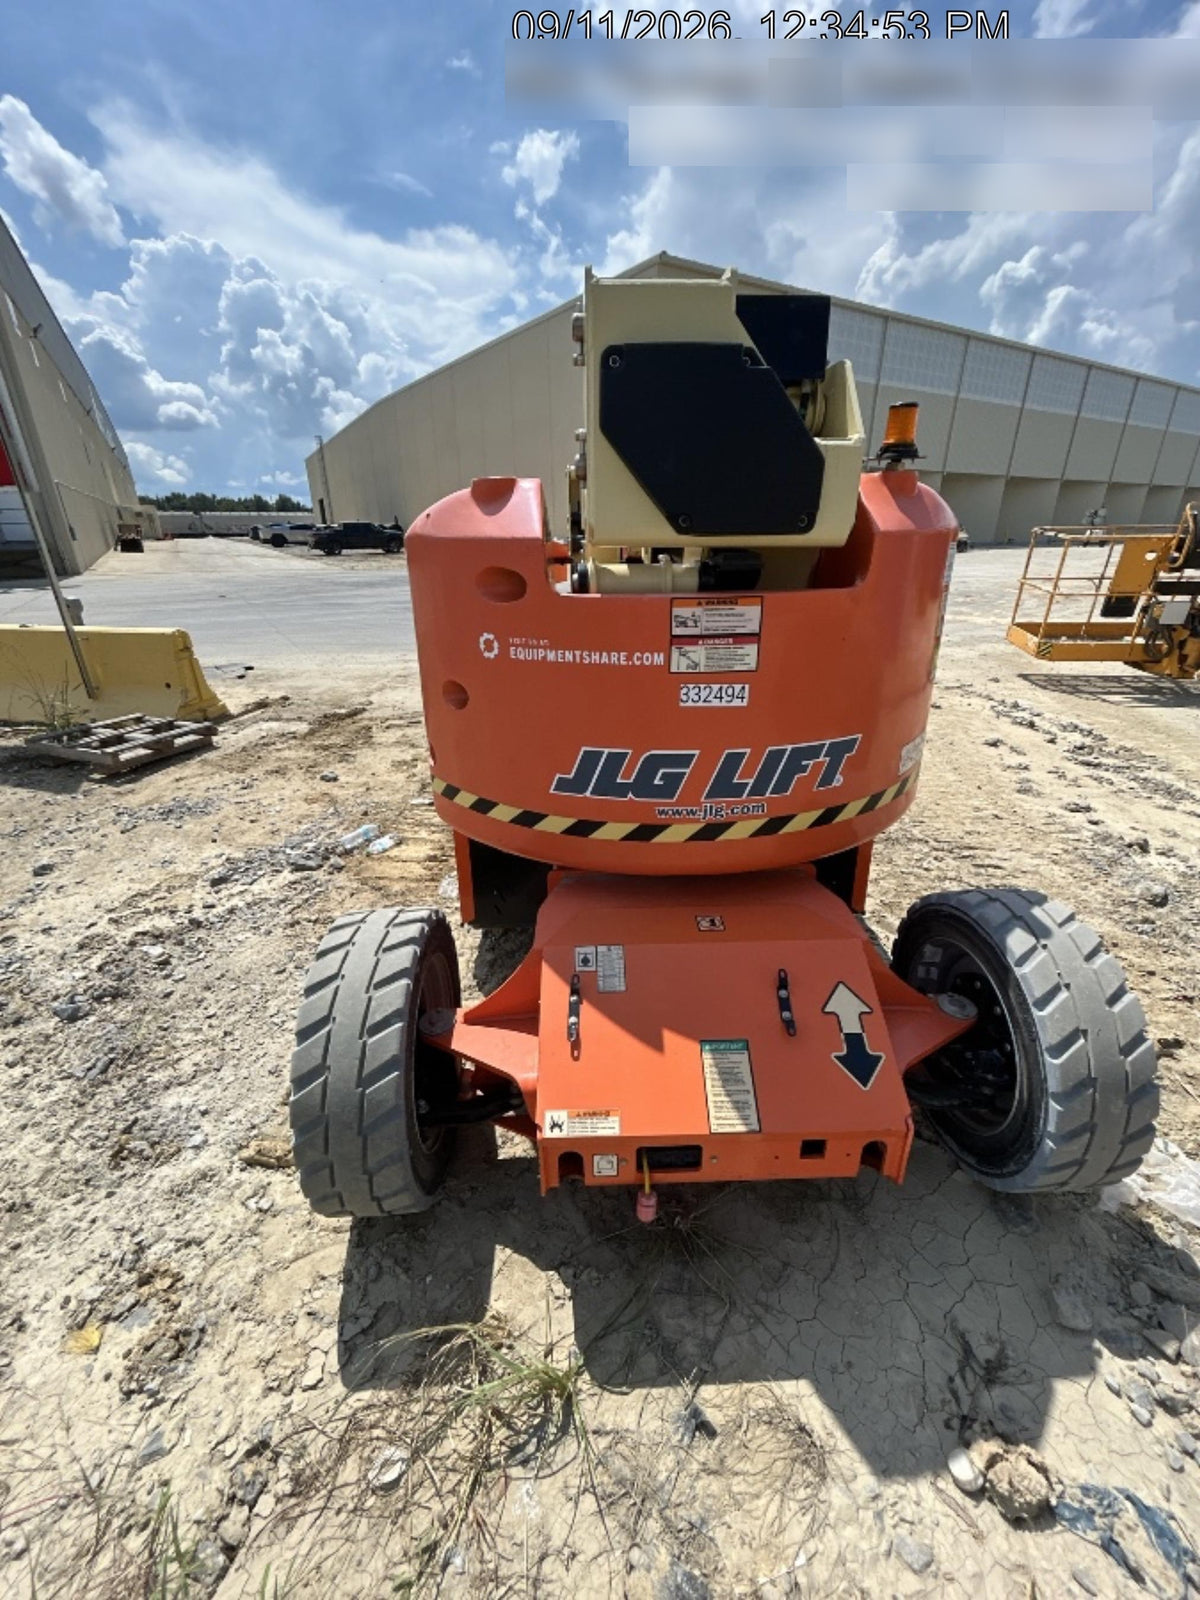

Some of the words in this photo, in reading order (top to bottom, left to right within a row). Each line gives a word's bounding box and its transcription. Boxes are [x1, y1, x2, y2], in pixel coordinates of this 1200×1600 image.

[509, 646, 665, 666] EQUIPMENTSHARE.COM
[680, 685, 746, 704] 332494
[550, 746, 700, 801] JLG
[702, 734, 862, 801] LIFT
[655, 802, 767, 821] www.jlg.com
